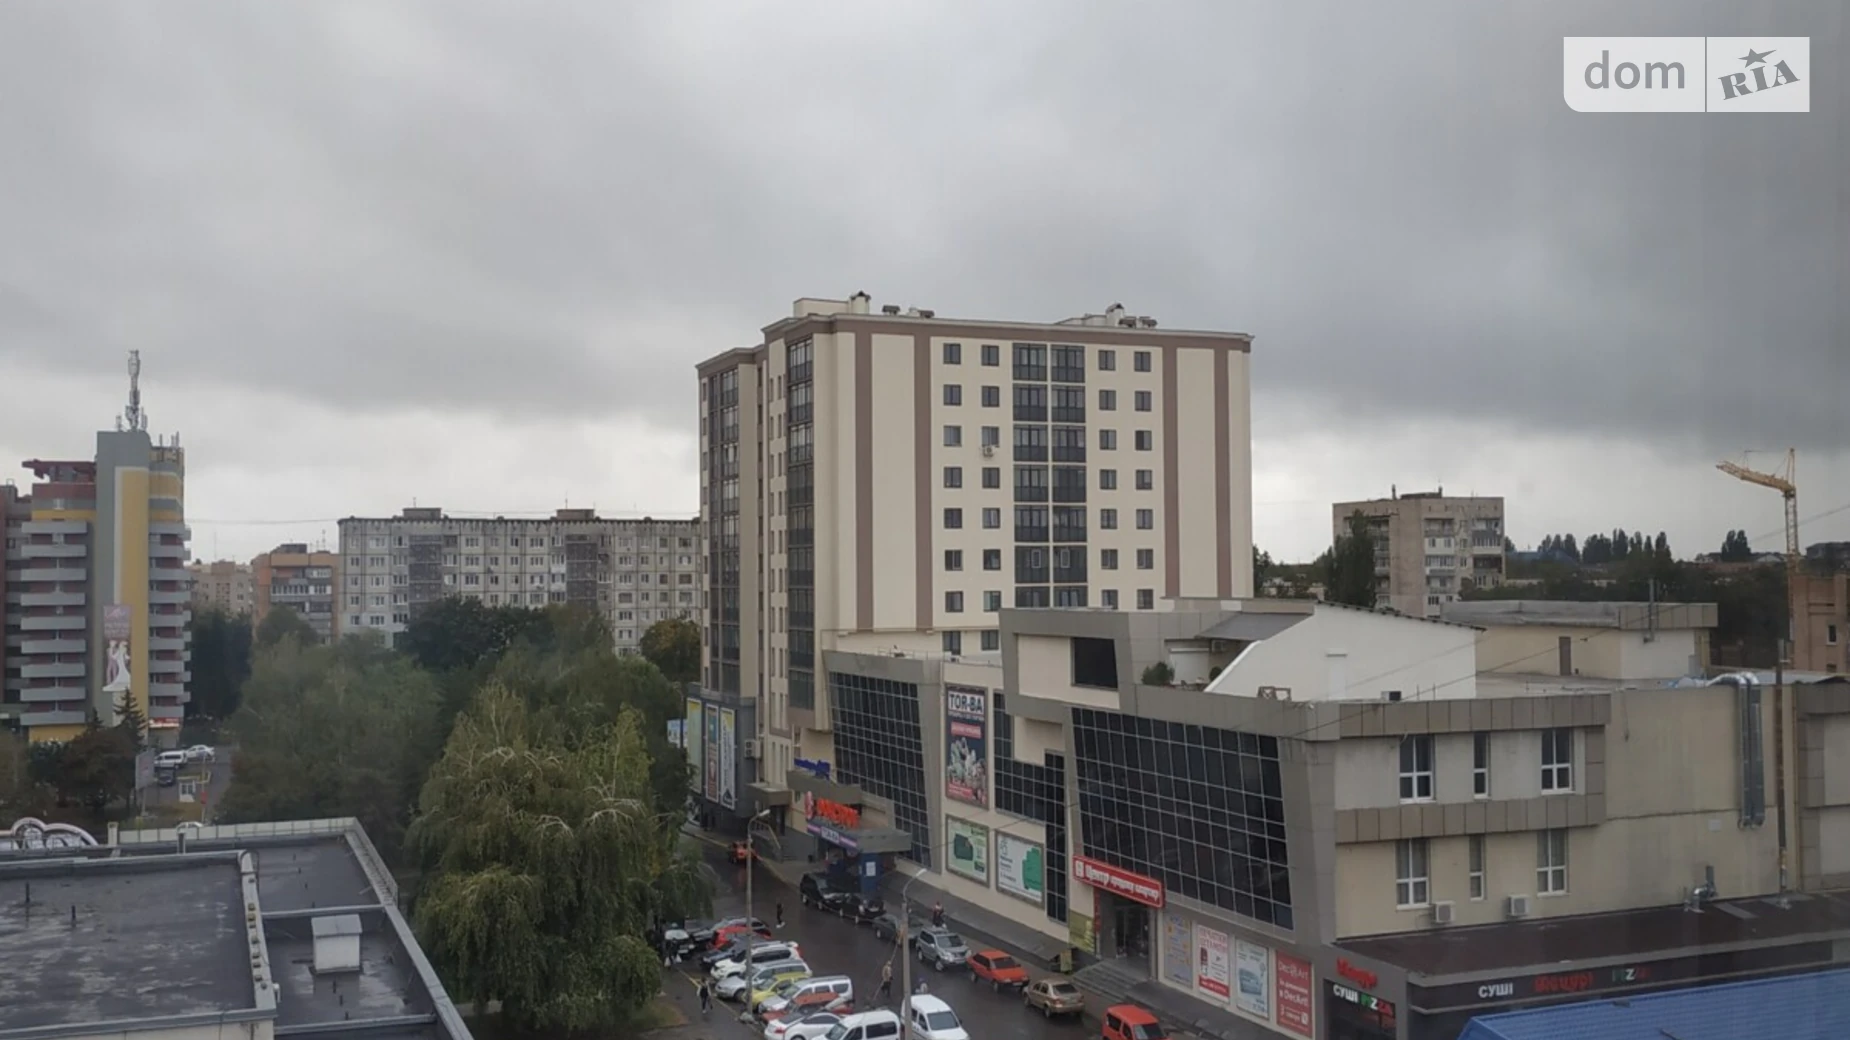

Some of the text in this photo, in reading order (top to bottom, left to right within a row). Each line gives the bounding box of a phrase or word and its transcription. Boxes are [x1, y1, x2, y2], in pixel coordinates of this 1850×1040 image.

[949, 694, 983, 713] TOR-BA
[1333, 984, 1359, 1003] СУШІ
[1478, 982, 1514, 998] СУШІ
